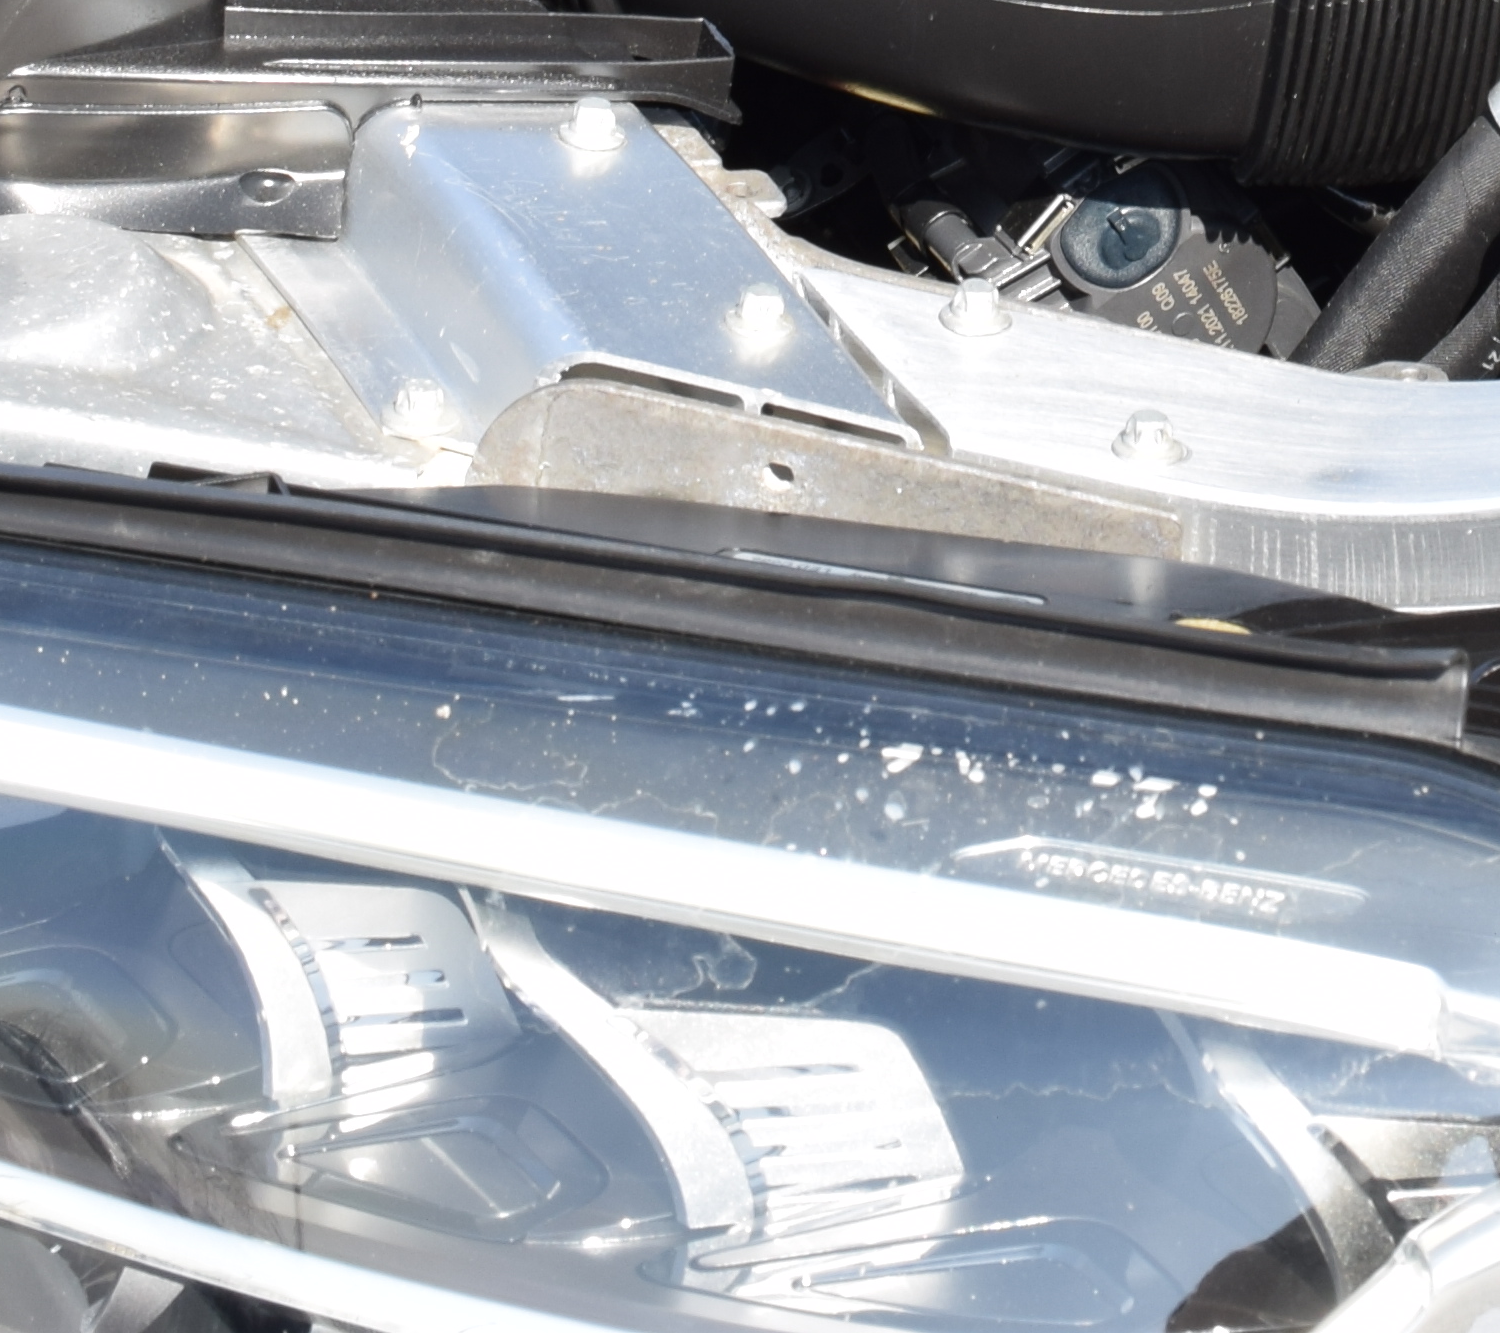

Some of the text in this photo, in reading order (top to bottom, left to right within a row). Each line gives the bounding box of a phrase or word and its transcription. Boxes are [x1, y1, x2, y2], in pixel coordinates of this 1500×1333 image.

[1151, 281, 1176, 312] Q09
[1173, 268, 1204, 305] 14047
[1202, 259, 1249, 326] 18226175E
[1018, 850, 1286, 914] MERCEDES-BENZ
